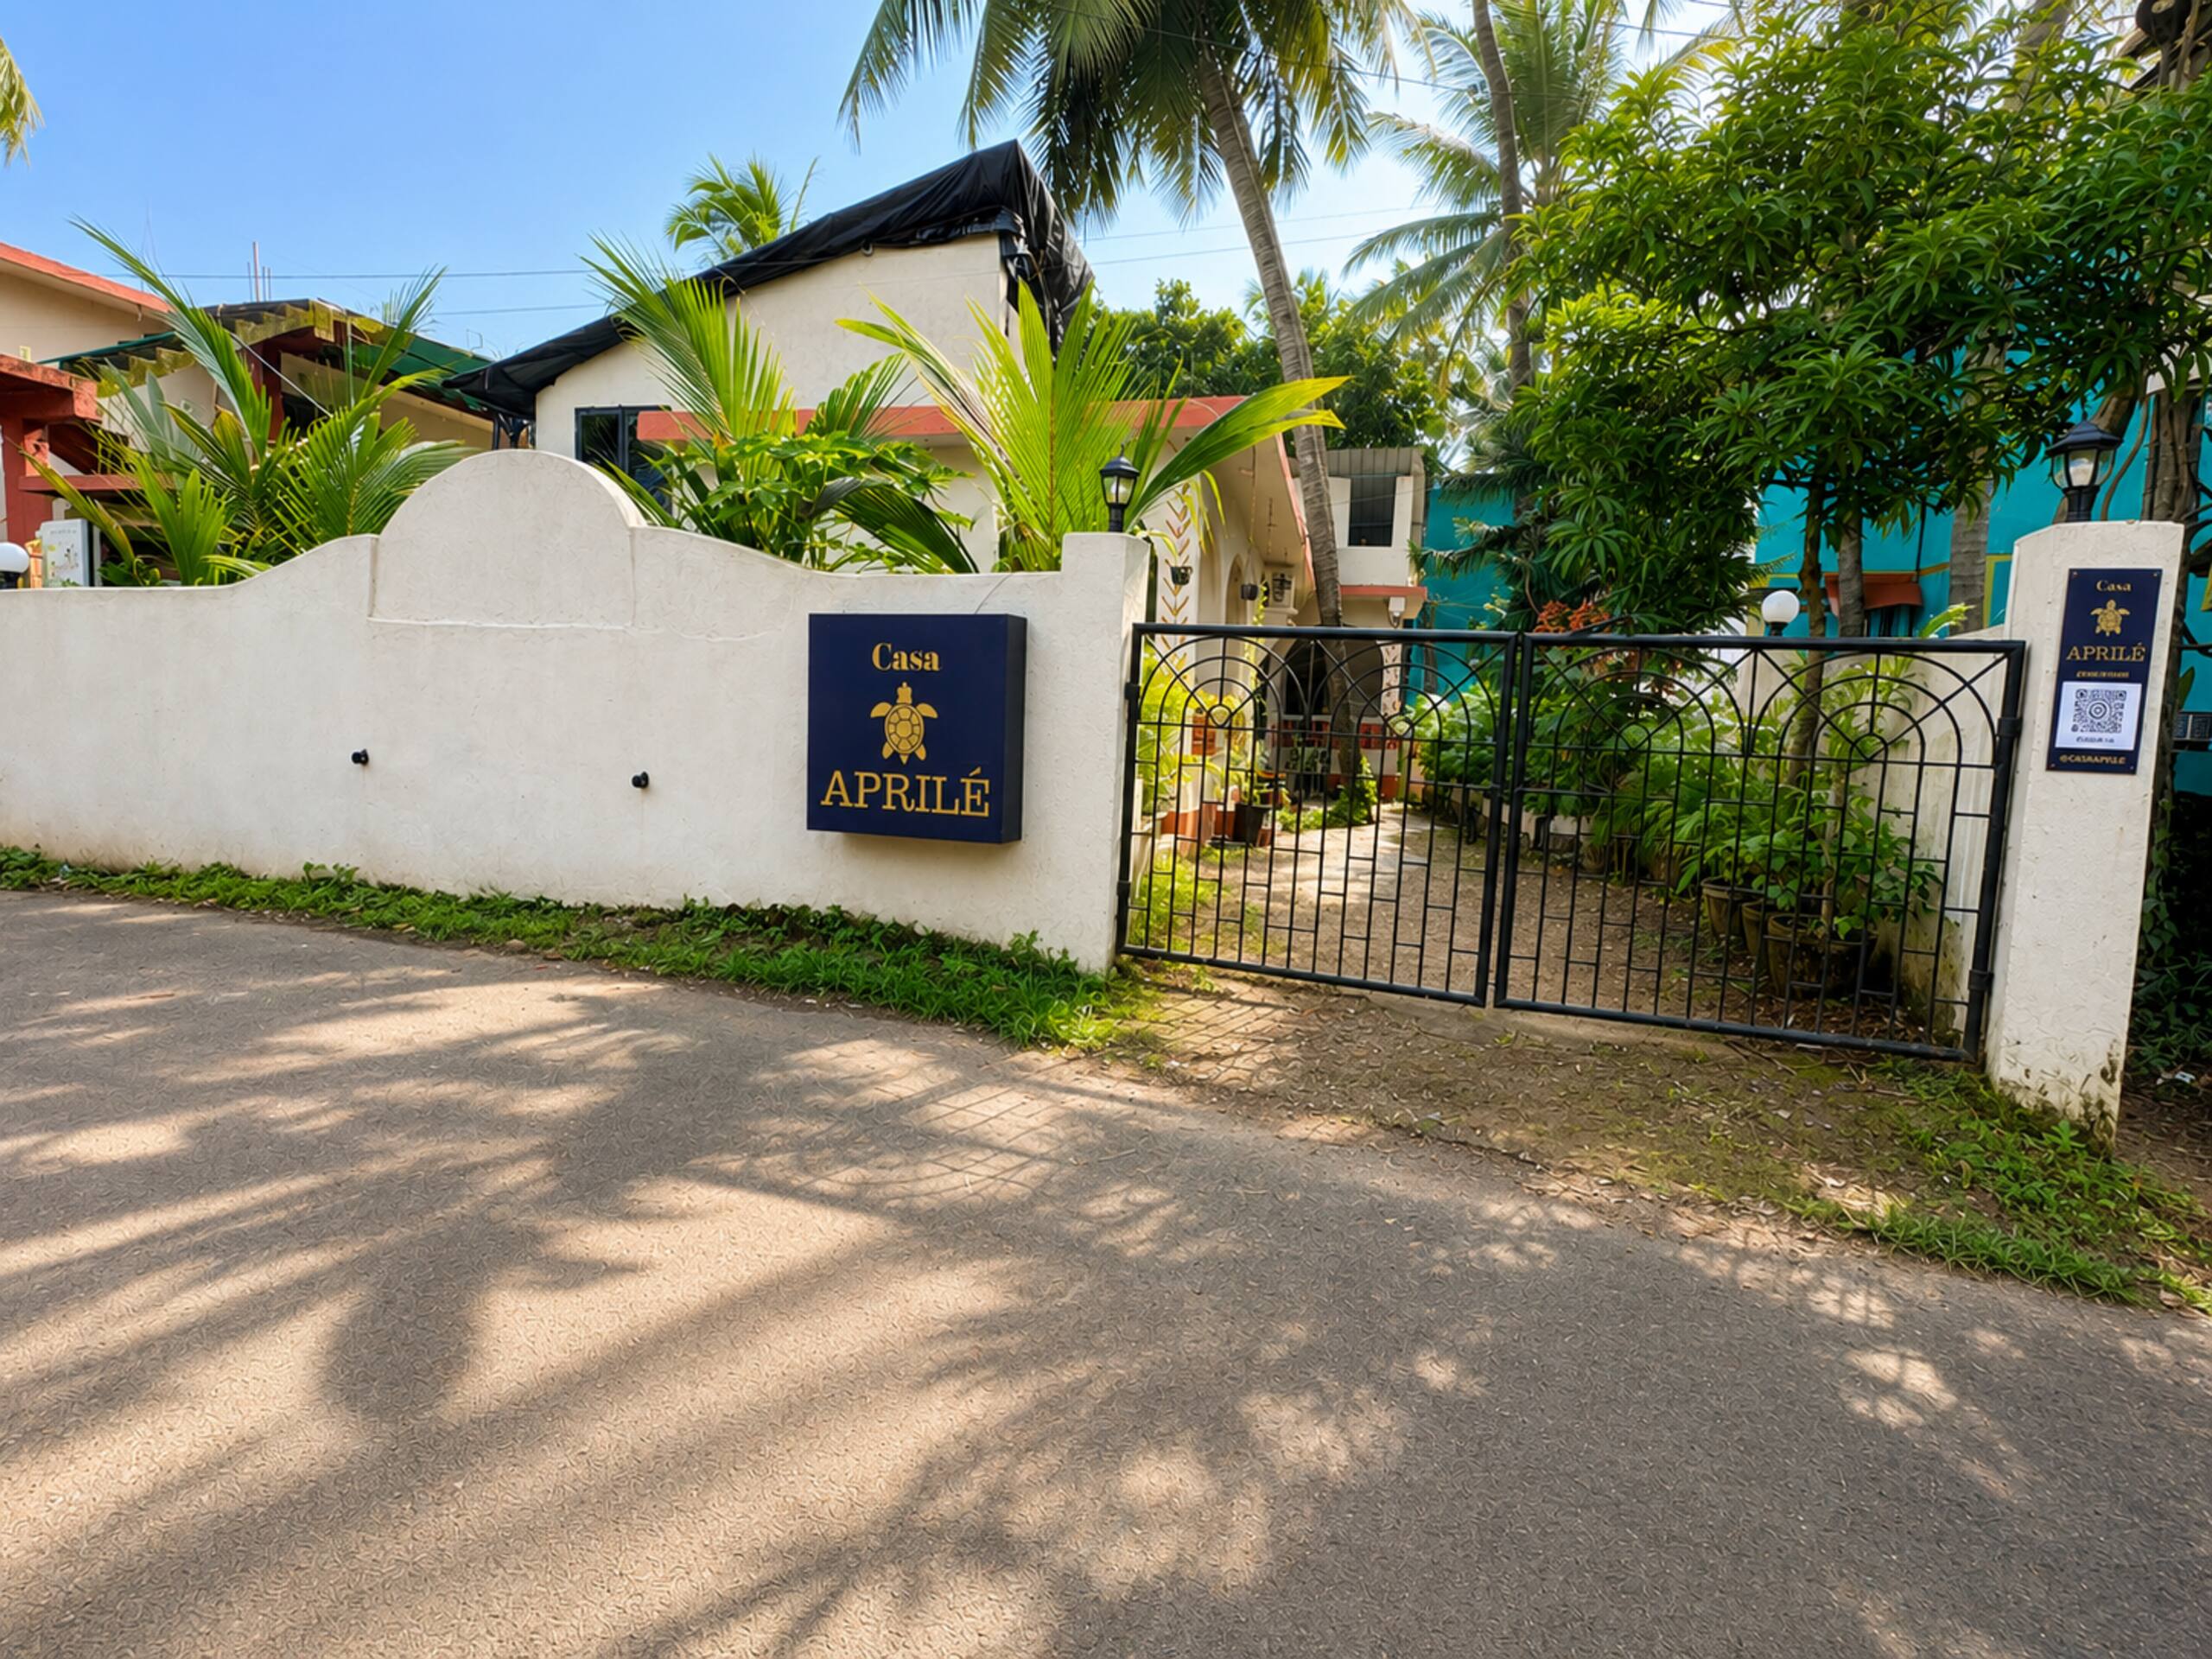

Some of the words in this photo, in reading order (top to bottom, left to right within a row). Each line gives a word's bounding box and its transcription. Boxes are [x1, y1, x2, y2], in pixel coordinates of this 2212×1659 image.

[2096, 580, 2132, 592] Casa
[872, 642, 940, 671] Casa
[2066, 642, 2145, 662] APRILÉ
[820, 766, 990, 817] APRILÉ
